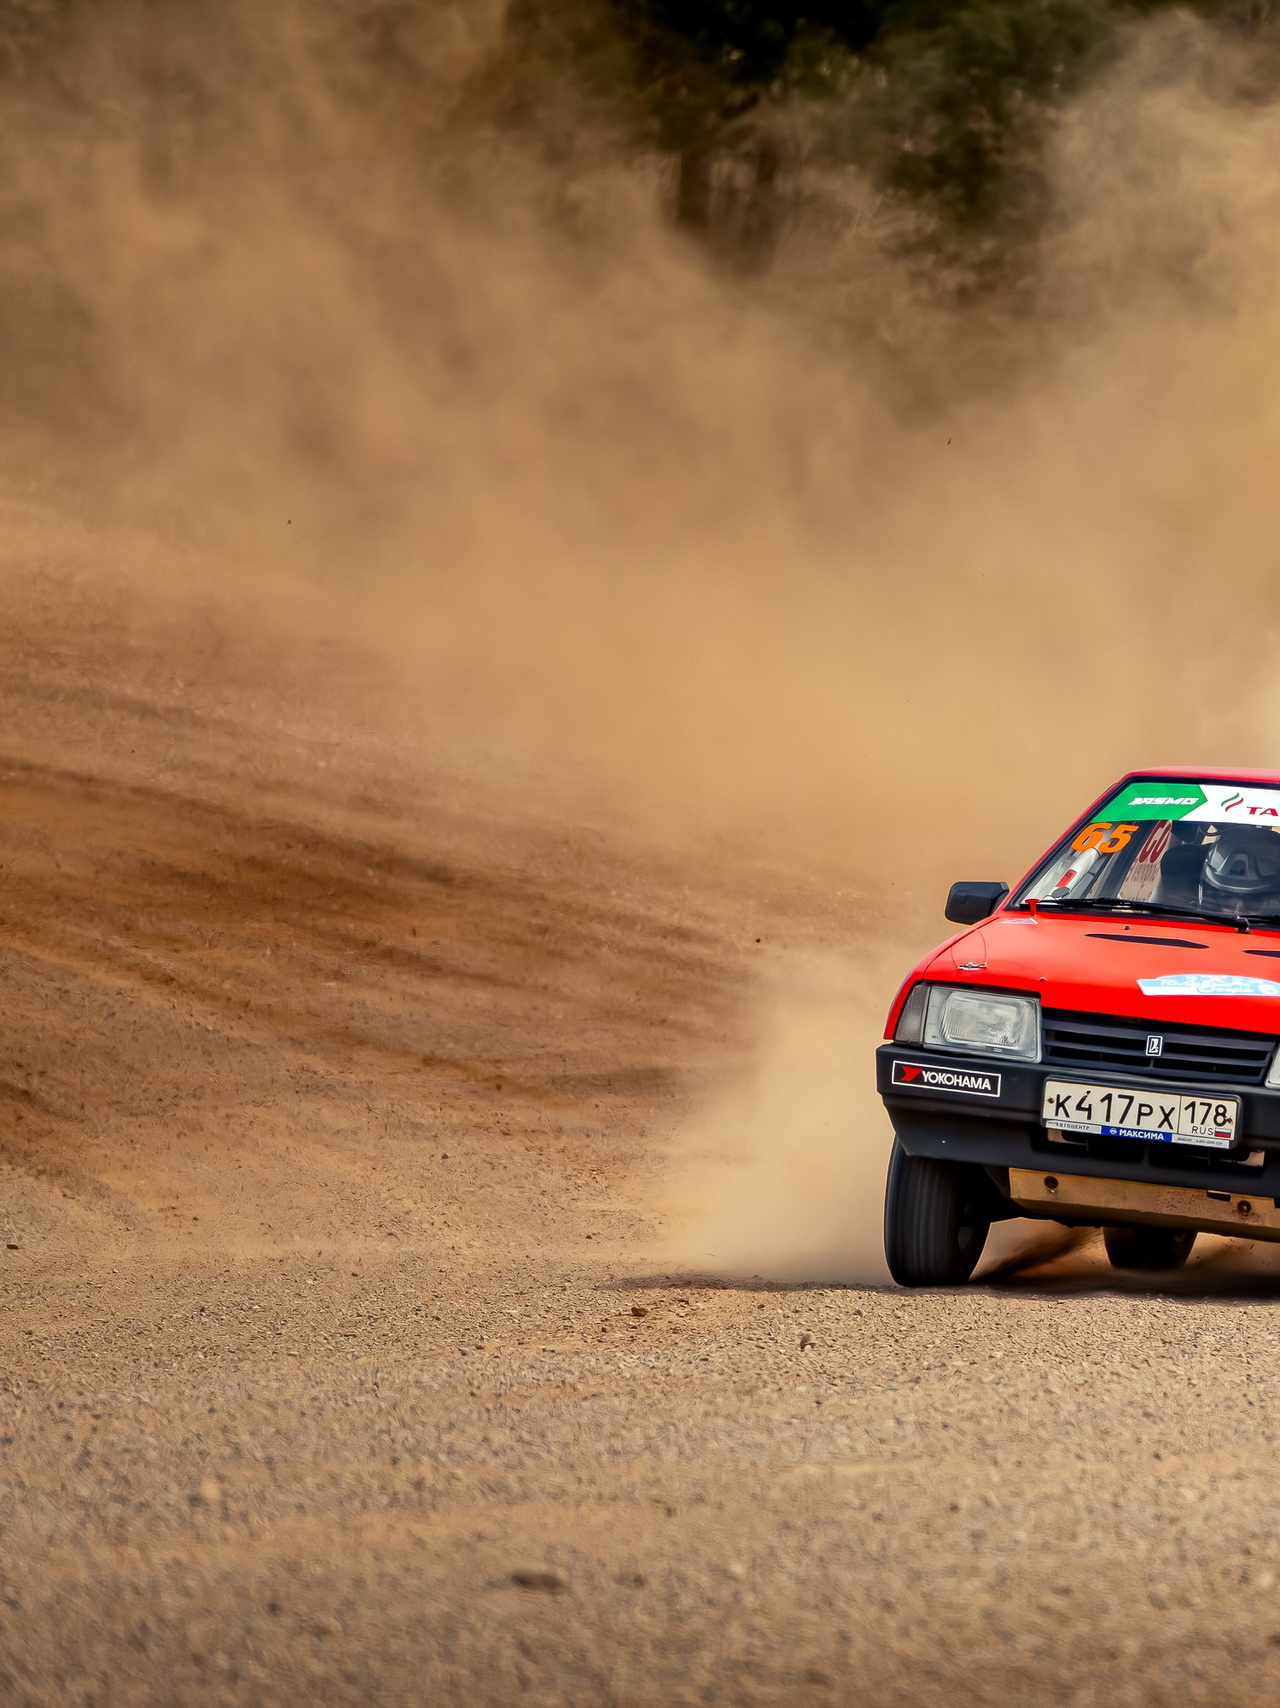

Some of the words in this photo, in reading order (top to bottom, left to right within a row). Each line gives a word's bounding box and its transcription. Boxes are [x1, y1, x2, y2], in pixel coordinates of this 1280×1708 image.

[1071, 822, 1139, 854] 65
[922, 1070, 992, 1091] YOKOHAMA
[1184, 1100, 1228, 1128] 178
[1119, 1128, 1164, 1141] МАКСИМА
[1191, 1126, 1214, 1136] RUS
